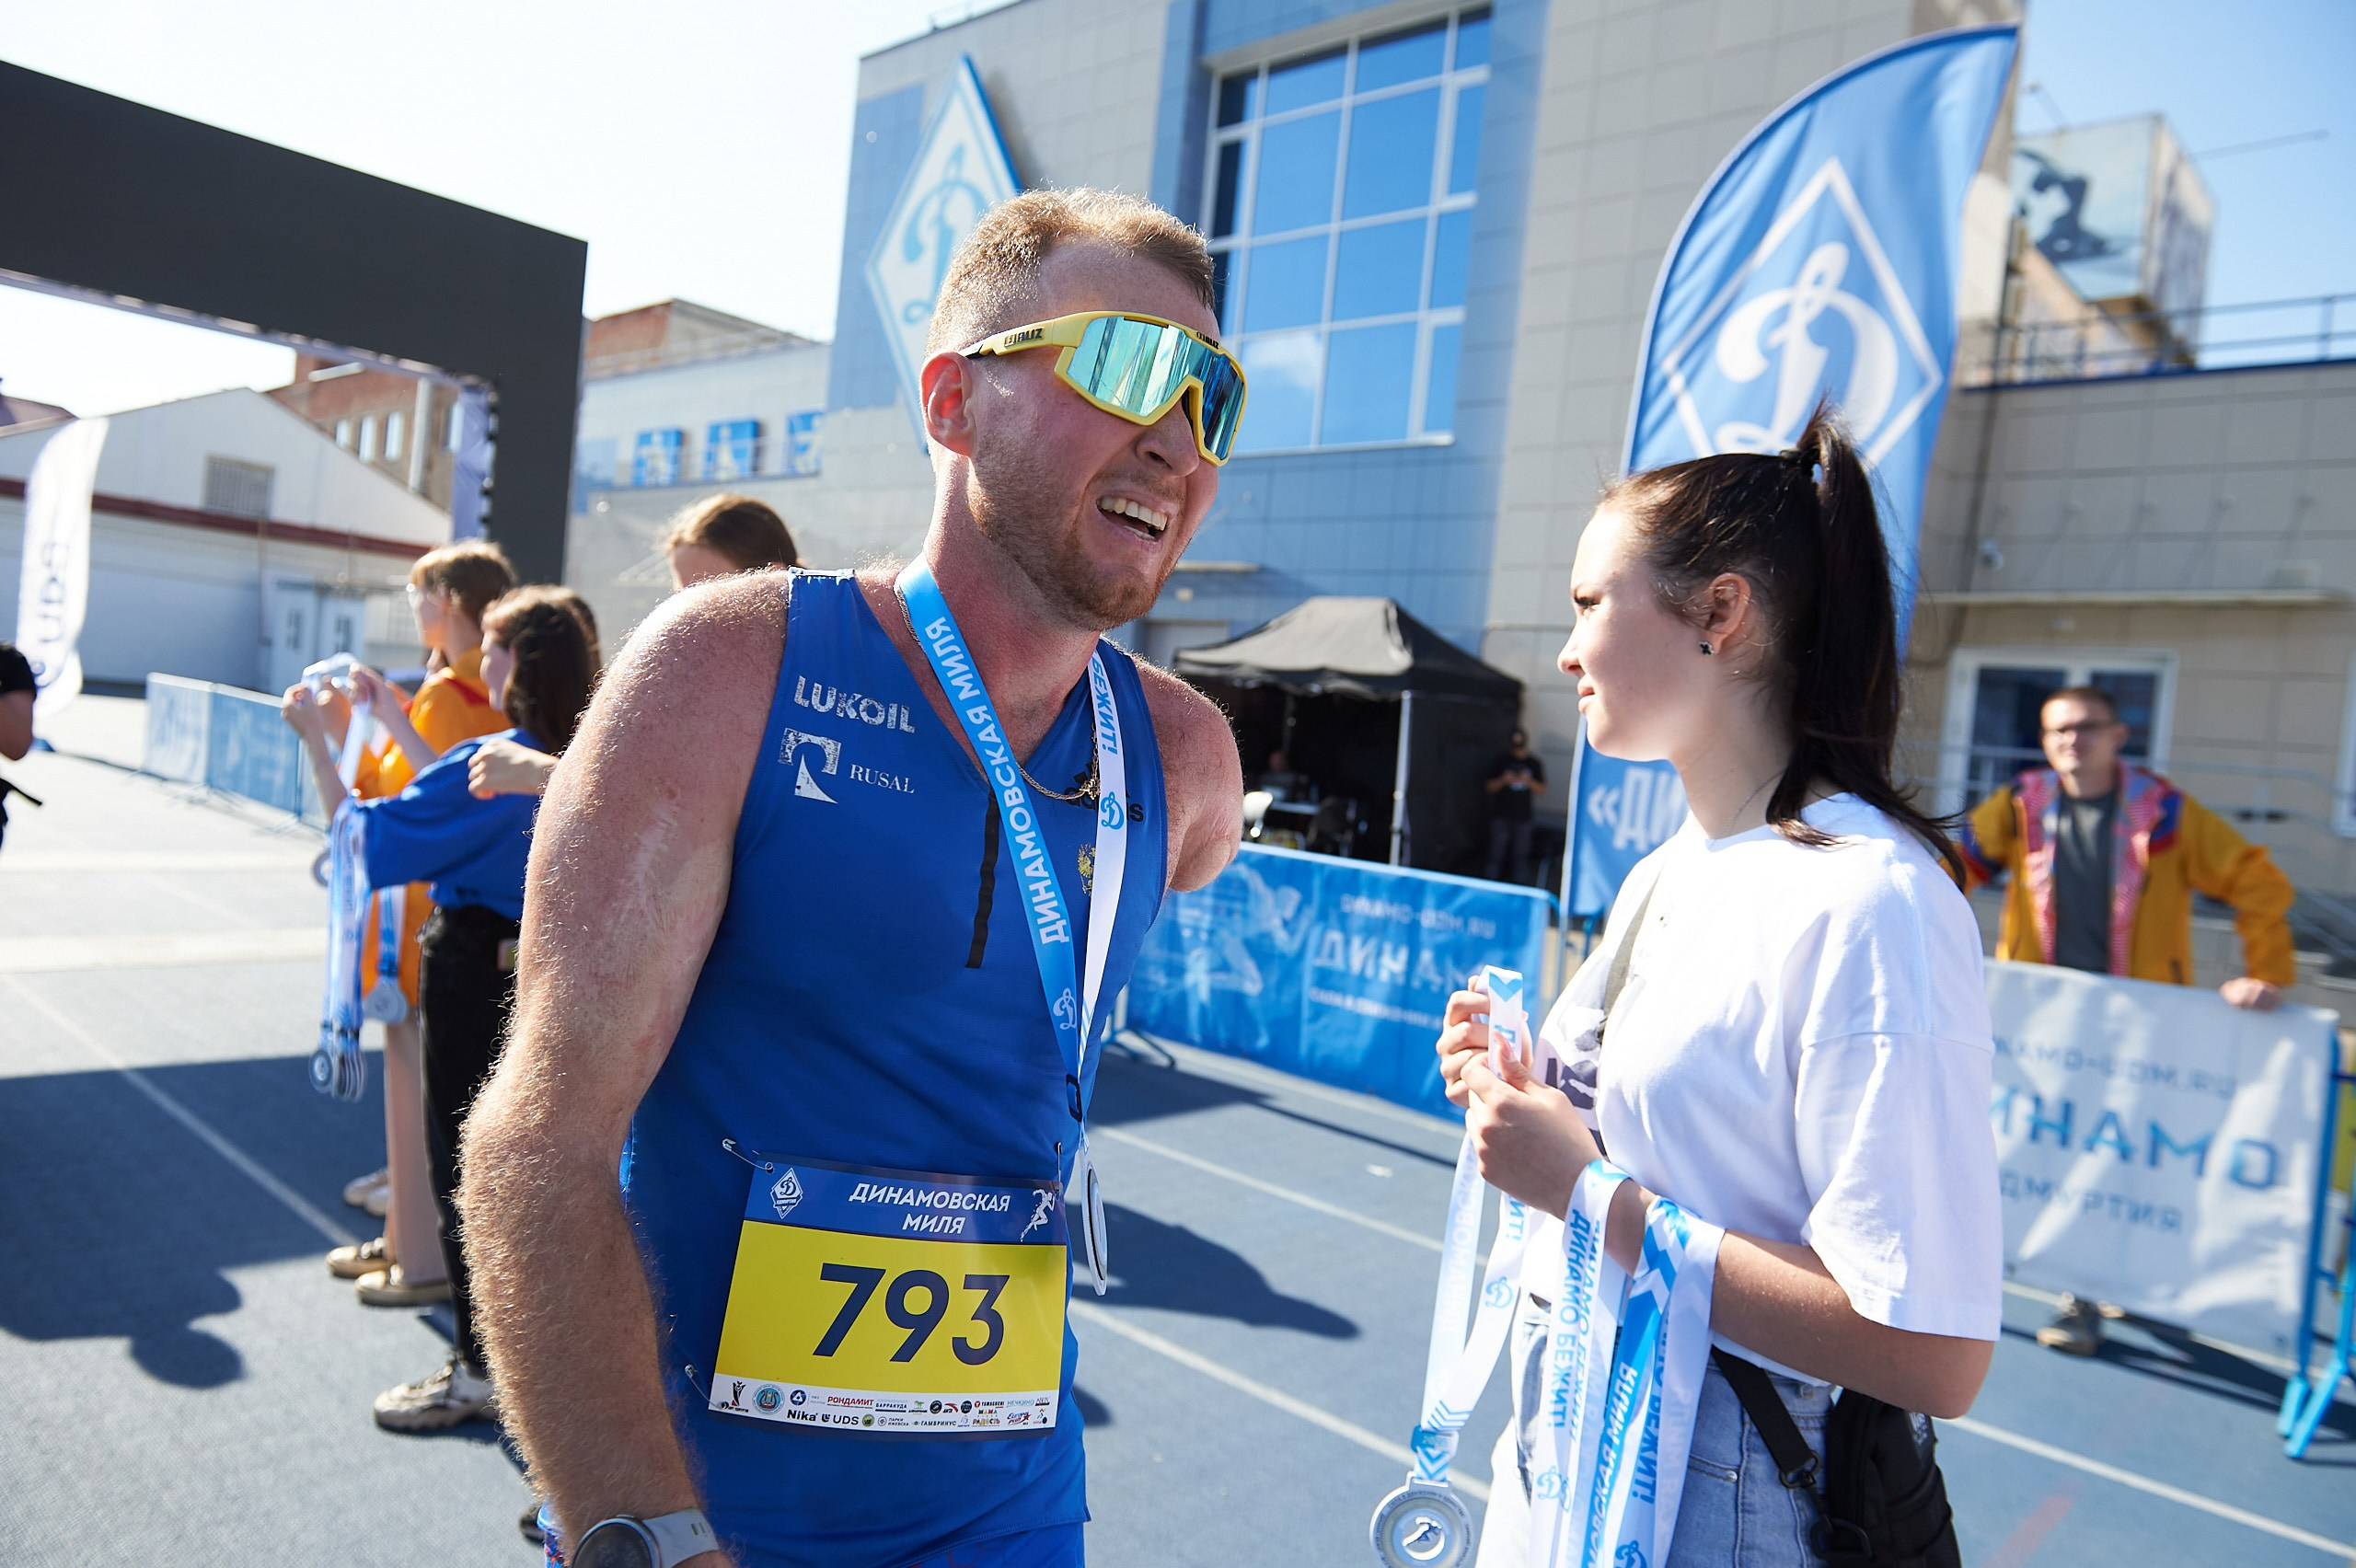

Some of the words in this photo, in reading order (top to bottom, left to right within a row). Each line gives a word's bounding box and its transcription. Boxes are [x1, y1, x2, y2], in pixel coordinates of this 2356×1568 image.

[925, 616, 982, 701] МИЛЯ
[794, 675, 916, 733] LUKOIL
[1091, 654, 1119, 755] БЕЖИТ!
[849, 764, 915, 794] RUSAL
[966, 704, 1071, 945] ДИНАМОВСКАЯ
[1990, 1087, 2279, 1190] ИНАМО
[849, 1183, 1011, 1213] ДИНАМОВСКАЯ
[902, 1213, 966, 1234] МИЛЯ
[2001, 1170, 2183, 1234] ДМУРТИЯ
[1559, 1209, 1591, 1324] ДИНАМО
[813, 1262, 1011, 1366] 793
[827, 1396, 875, 1406] РОНДАМИТ
[1547, 1333, 1576, 1429] БЕЖИТ!
[833, 1415, 860, 1425] UDS
